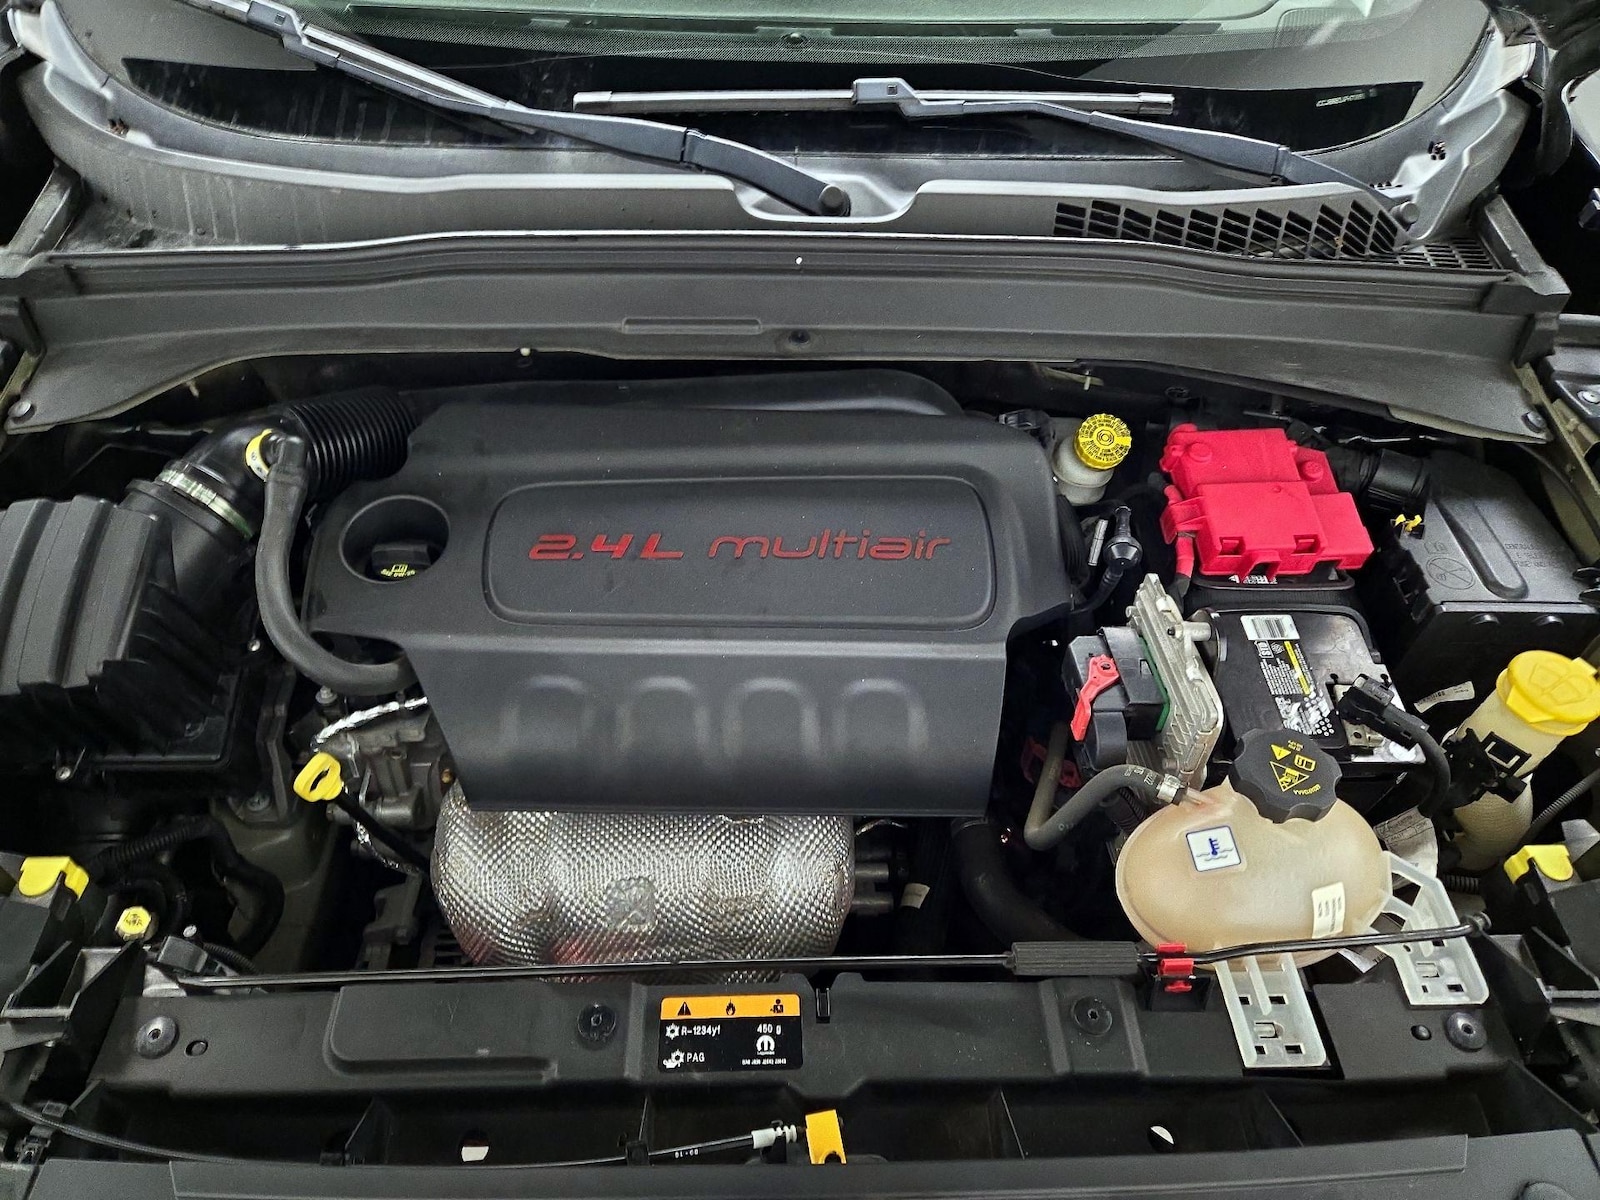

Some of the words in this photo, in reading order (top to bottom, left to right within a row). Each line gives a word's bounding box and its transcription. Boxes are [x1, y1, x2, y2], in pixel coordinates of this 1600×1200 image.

[528, 533, 684, 561] 2.4L
[708, 528, 952, 560] multiair
[681, 1024, 721, 1037] R-1234yf
[686, 1052, 705, 1062] PAG
